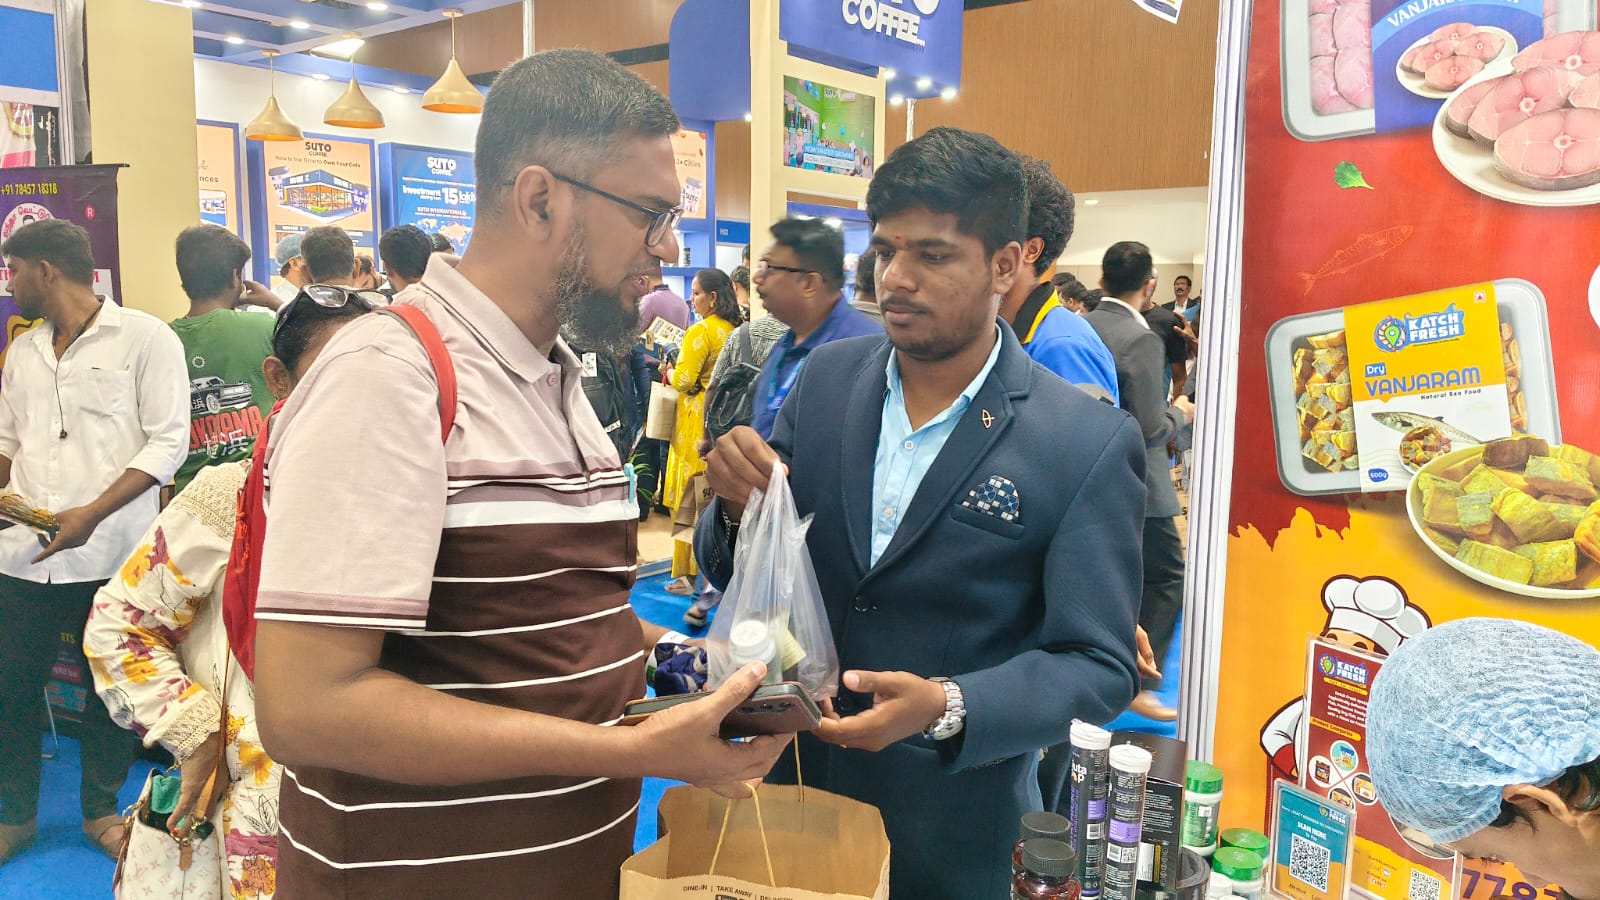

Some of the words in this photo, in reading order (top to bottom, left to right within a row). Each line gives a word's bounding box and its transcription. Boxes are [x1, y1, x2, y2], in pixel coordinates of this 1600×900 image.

[305, 142, 332, 152] SUTO
[427, 157, 456, 170] SUTO
[1, 184, 13, 195] +91
[442, 188, 459, 204] 15
[1408, 312, 1459, 331] KATCH
[1409, 324, 1460, 342] FRESH
[1366, 366, 1385, 375] Dry
[1365, 367, 1481, 396] VANJARAM
[1336, 661, 1366, 676] KATCH
[1336, 670, 1365, 684] FRESH
[1297, 821, 1312, 833] SCAN
[1311, 827, 1327, 840] HERE
[716, 885, 734, 894] TAKE
[734, 889, 753, 898] AWAY
